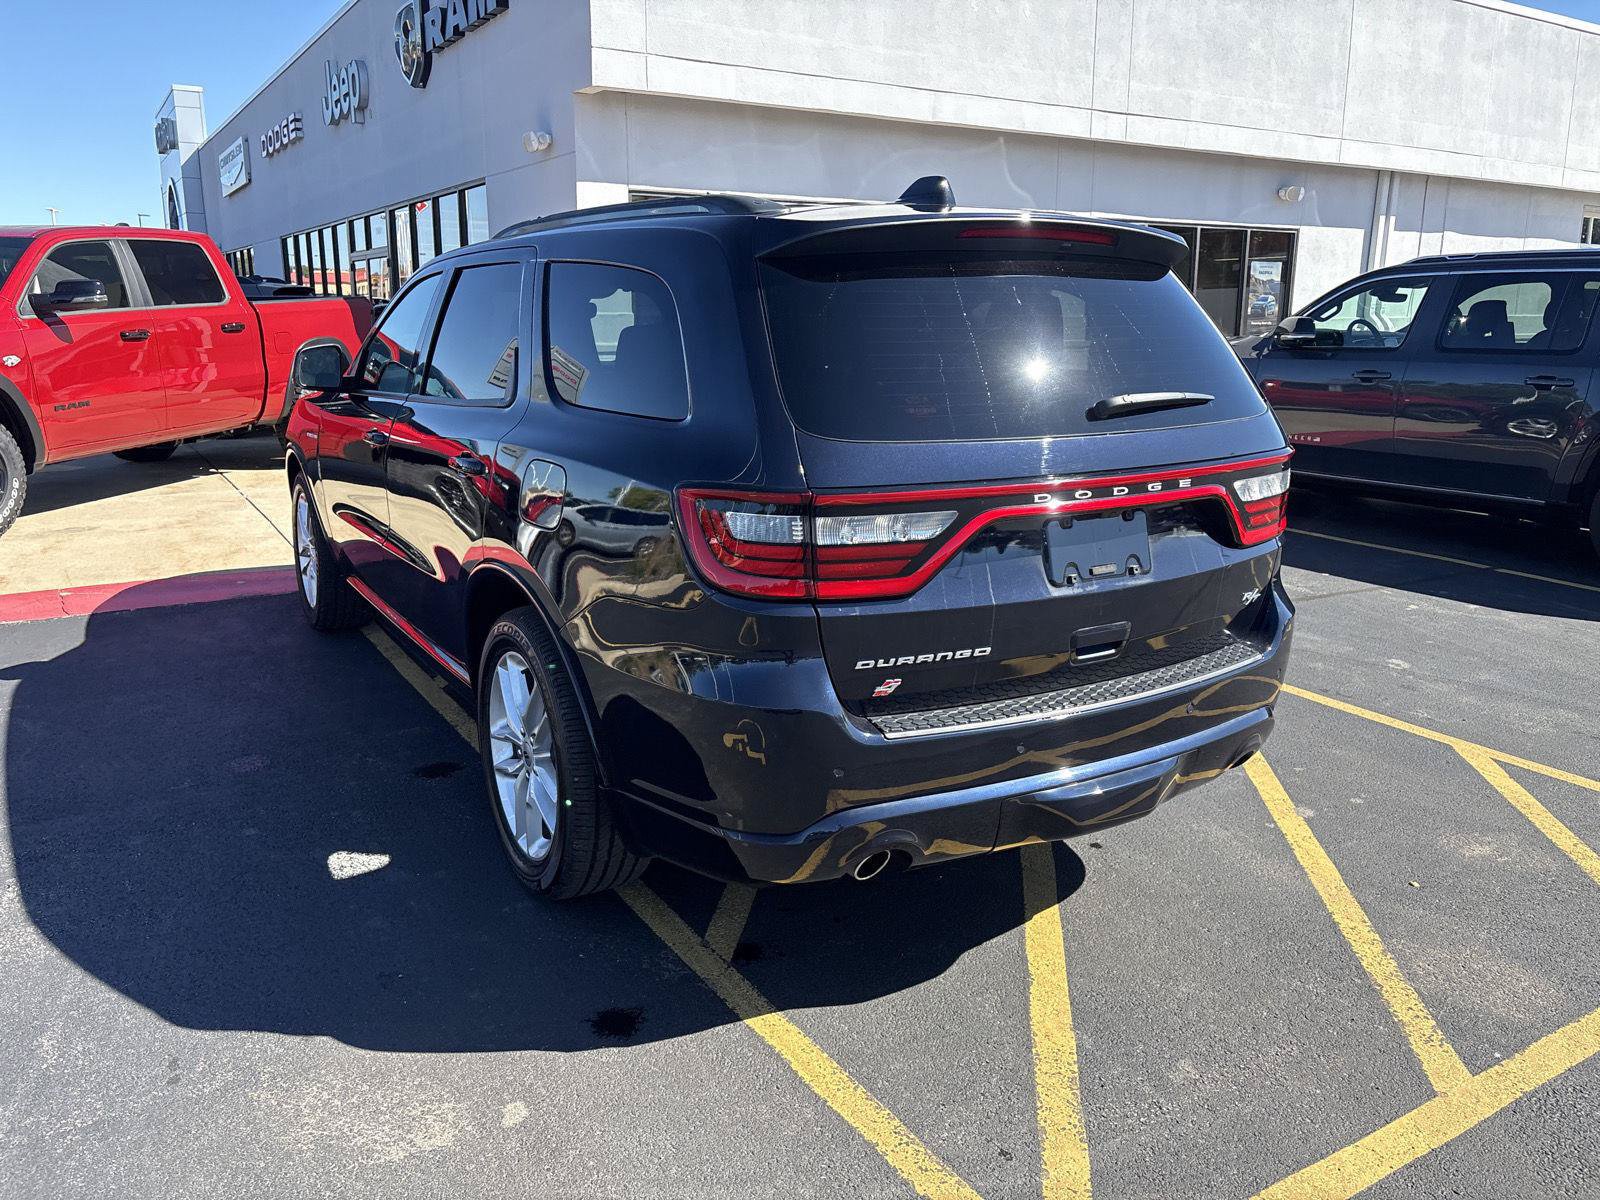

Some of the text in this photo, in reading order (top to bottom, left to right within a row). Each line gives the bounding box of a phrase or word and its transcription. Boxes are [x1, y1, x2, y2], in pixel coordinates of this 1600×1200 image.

[321, 59, 366, 126] Jeep
[260, 112, 301, 158] DODGE
[54, 401, 91, 412] RAM
[1033, 478, 1192, 504] DODGE
[1241, 588, 1262, 606] R/T
[855, 646, 992, 670] DURANGO
